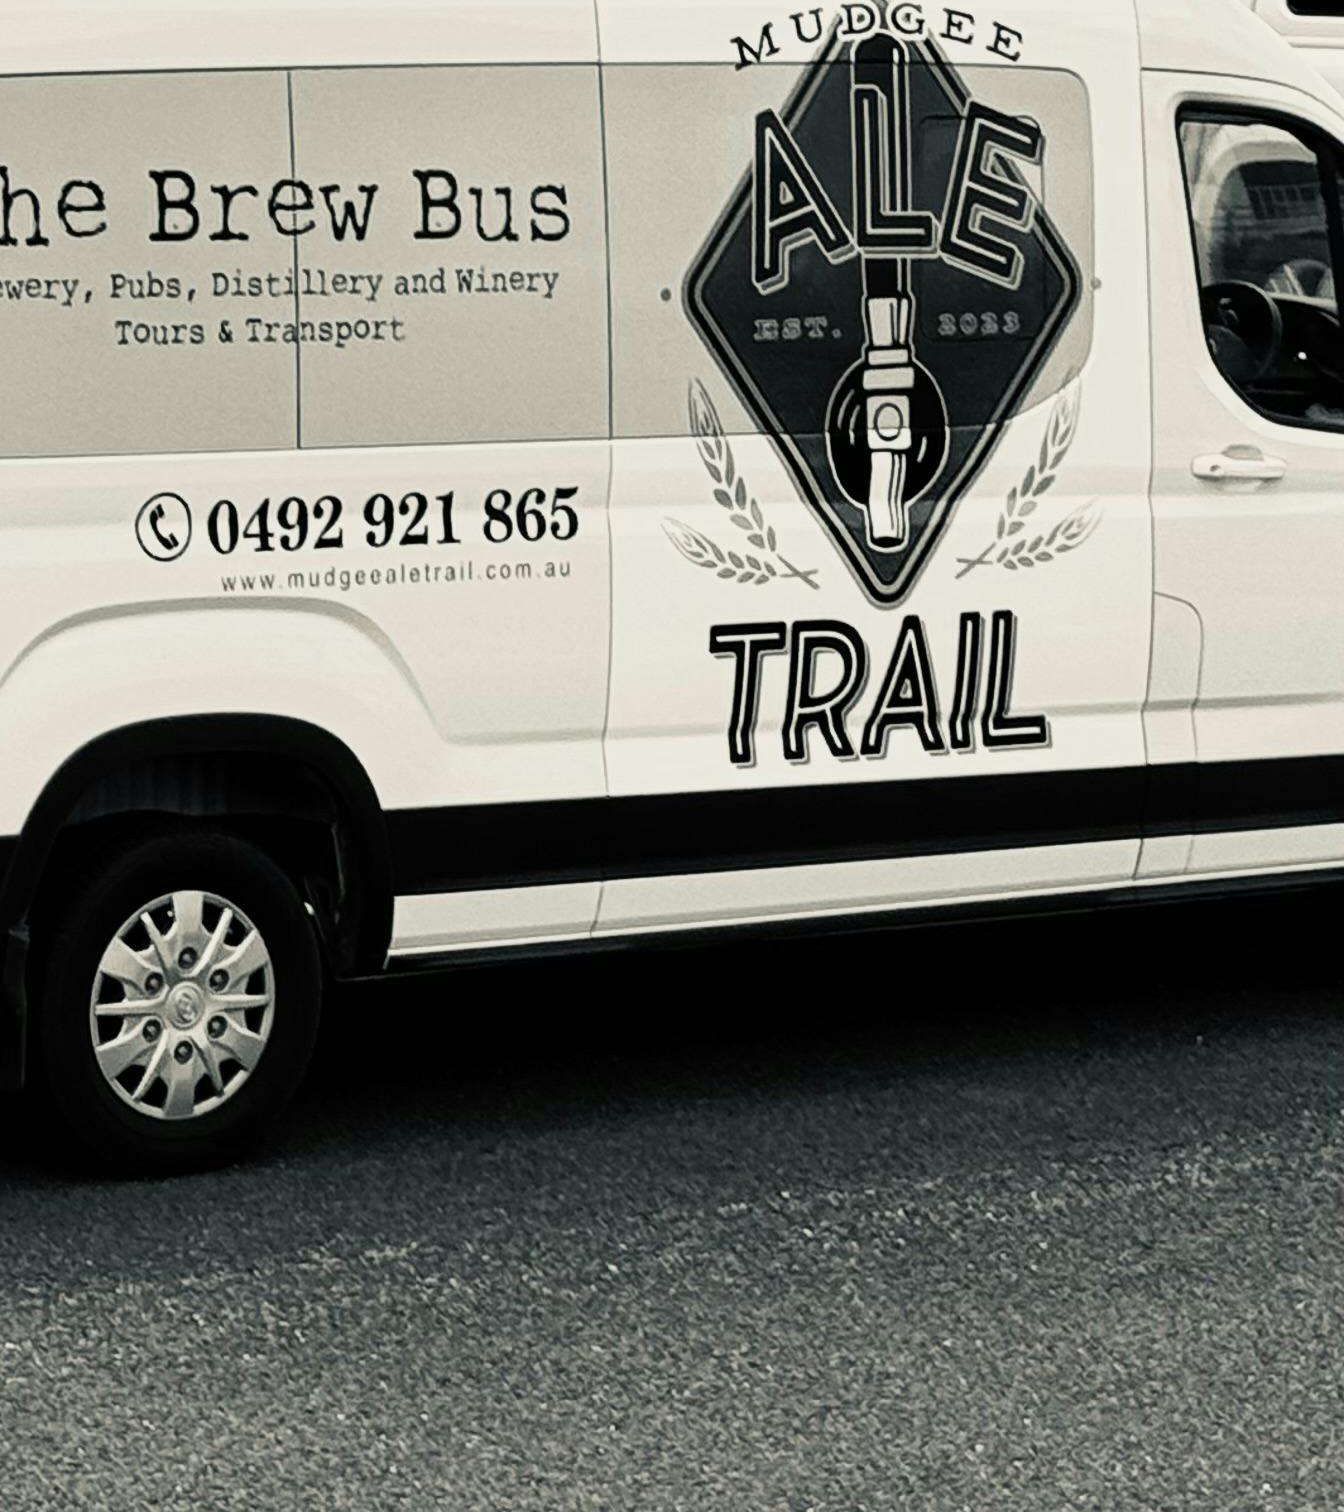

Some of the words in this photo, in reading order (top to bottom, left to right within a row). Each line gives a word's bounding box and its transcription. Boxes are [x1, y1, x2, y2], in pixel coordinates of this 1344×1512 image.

[147, 170, 380, 245] Brew
[412, 168, 571, 245] Bus
[752, 84, 1045, 293] ALE
[110, 271, 199, 301] Pubs,
[211, 268, 383, 302] Distillery
[393, 268, 447, 296] and
[454, 266, 560, 300] Winery
[114, 319, 206, 346] Tours
[218, 319, 234, 345] &
[245, 315, 406, 350] Transport
[207, 494, 344, 556] 0492
[362, 489, 462, 550] 921
[482, 485, 580, 544] 865
[709, 609, 1053, 769] TRAIL
